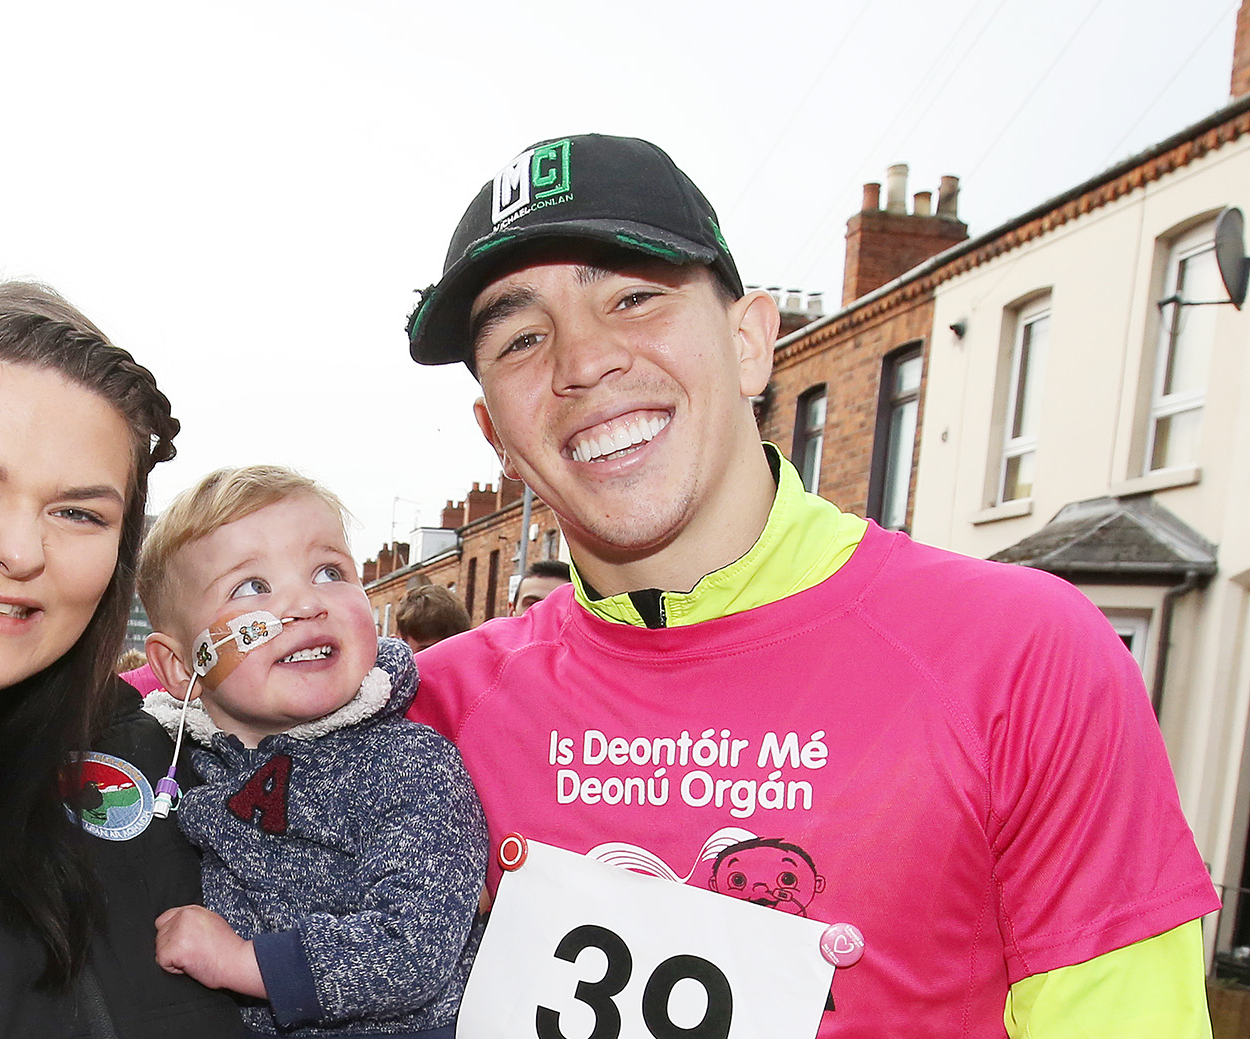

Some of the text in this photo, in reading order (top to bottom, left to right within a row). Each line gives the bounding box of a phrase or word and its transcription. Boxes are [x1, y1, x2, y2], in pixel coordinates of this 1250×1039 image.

[549, 728, 829, 769] Is Deontóir Mé
[557, 767, 813, 819] Deonú Orgán
